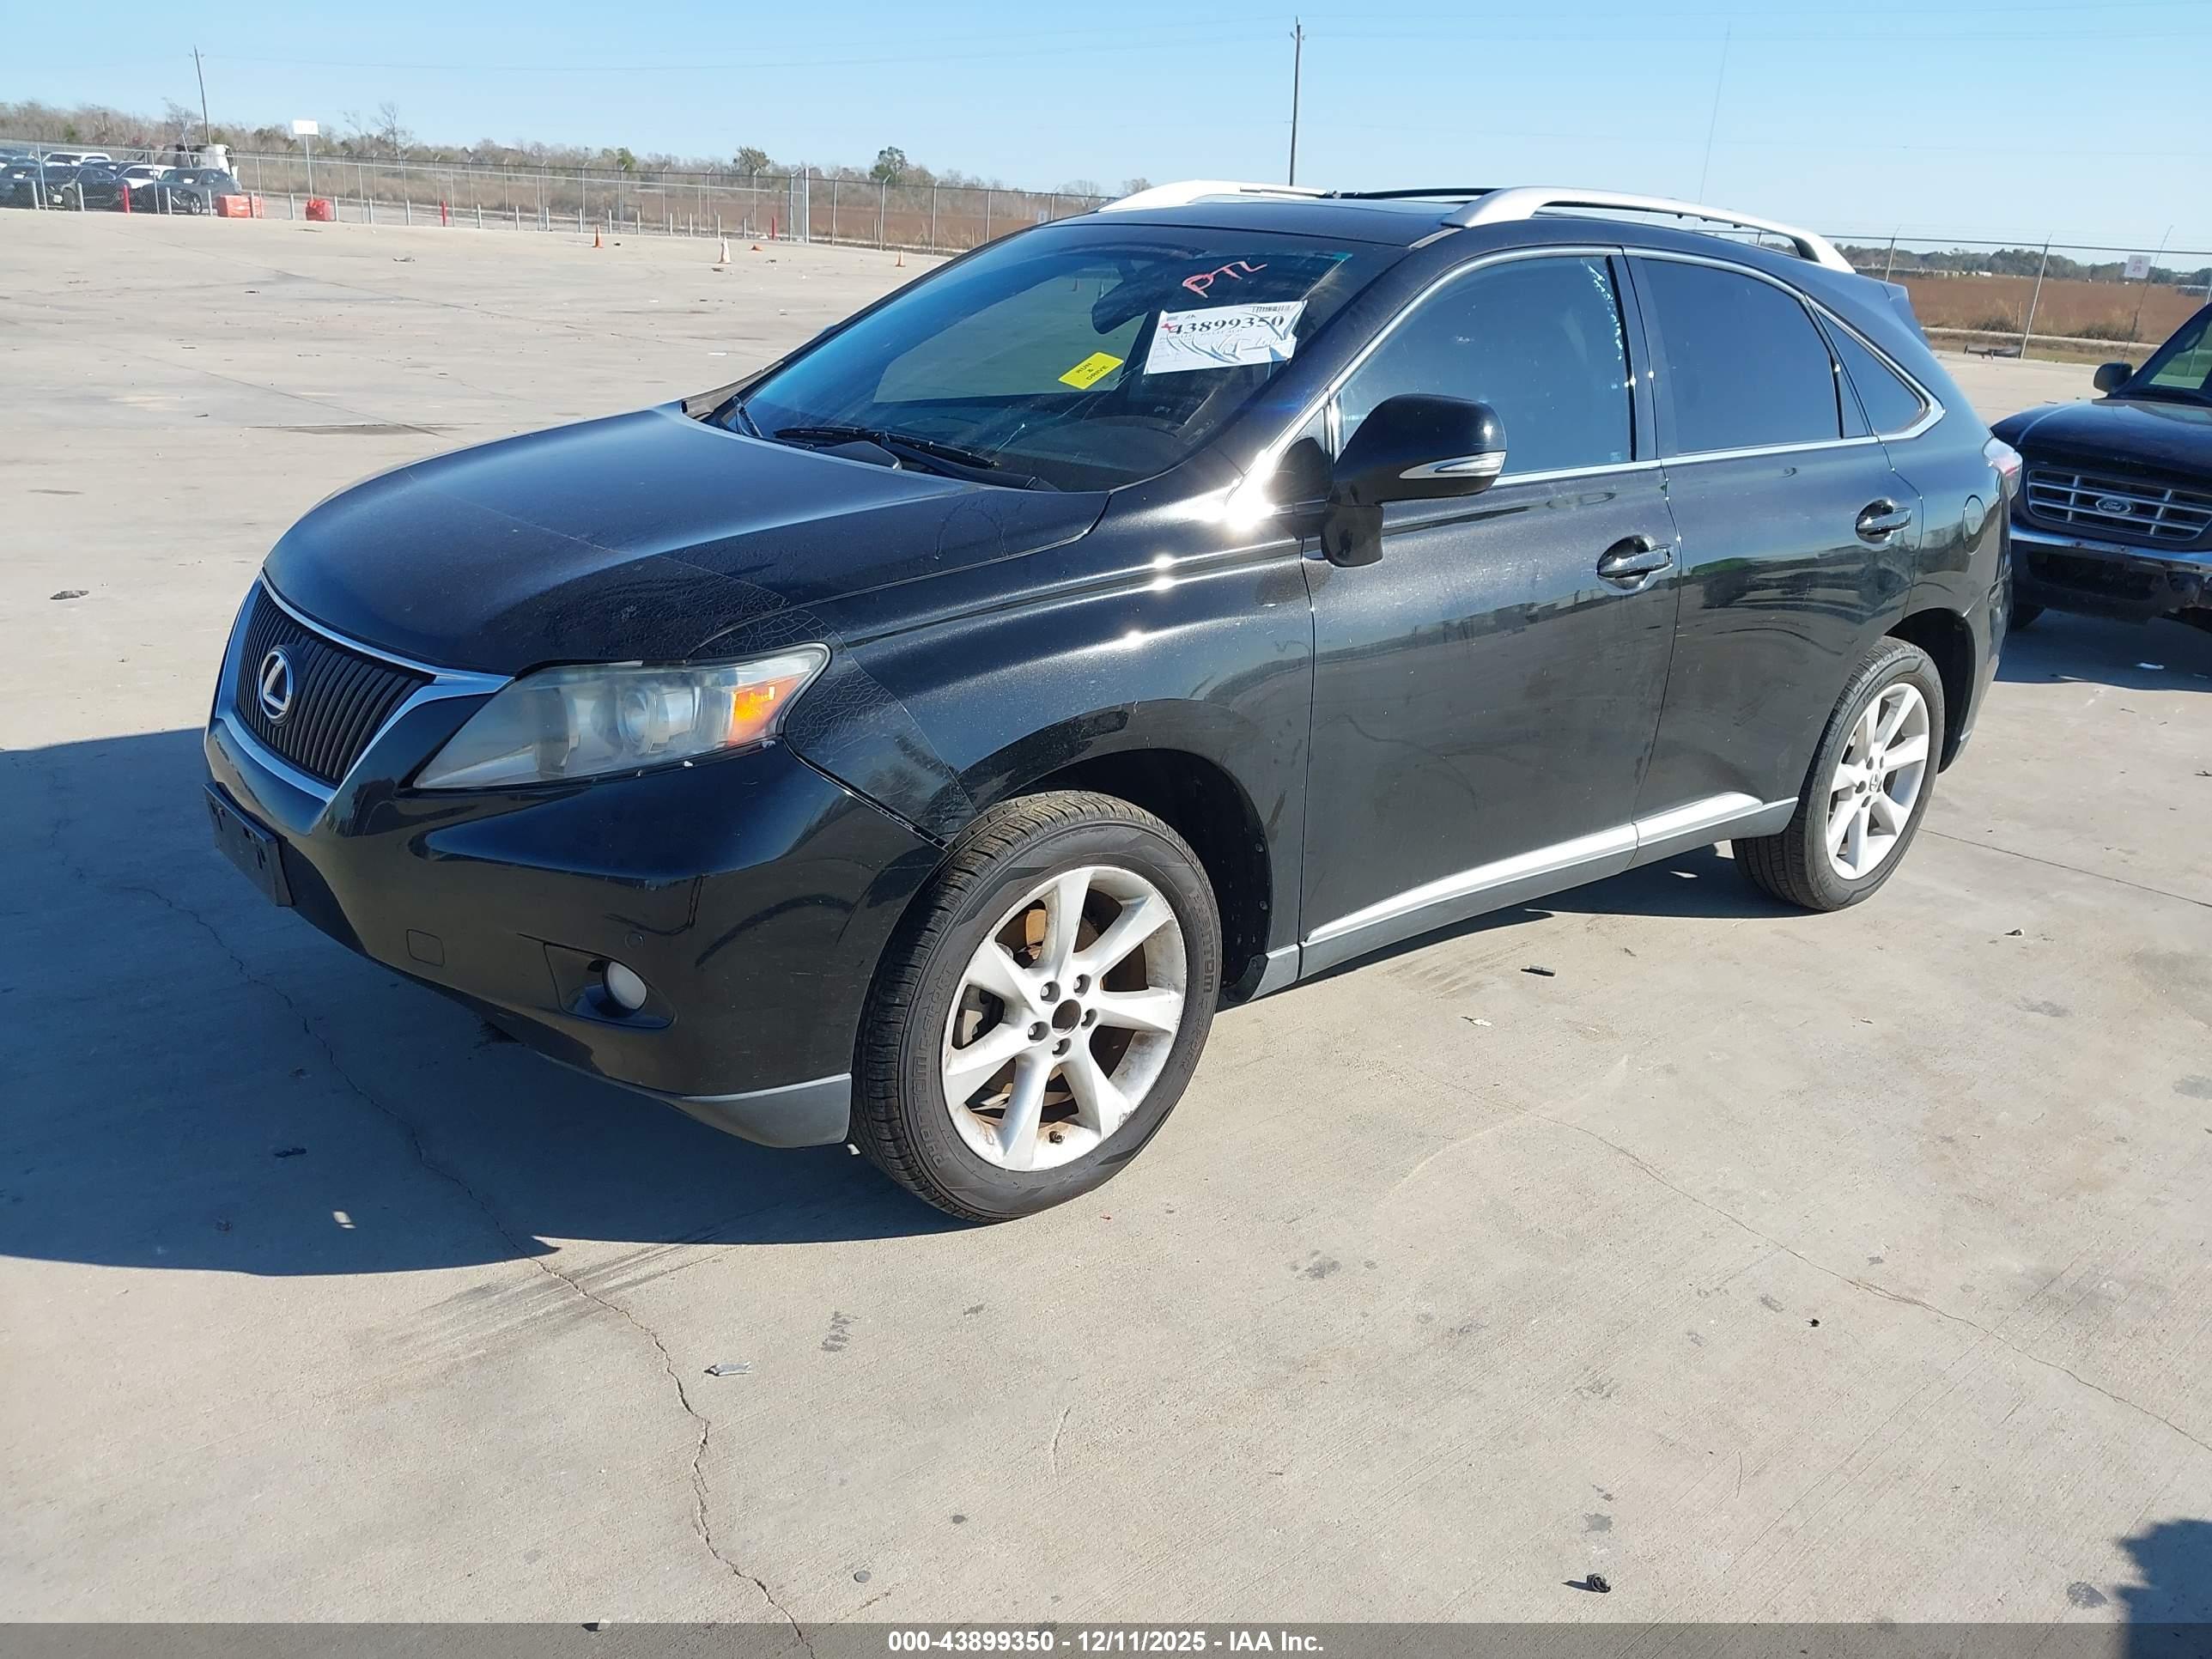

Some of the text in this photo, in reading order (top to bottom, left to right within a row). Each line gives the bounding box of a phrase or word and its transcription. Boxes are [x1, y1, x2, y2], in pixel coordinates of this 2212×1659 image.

[1170, 314, 1285, 336] 43899350
[1076, 362, 1092, 374] RUN
[1085, 365, 1109, 380] DRIVE
[1188, 891, 1215, 994] PHANTOM
[912, 960, 957, 1170] PHANTOM C-SPORT
